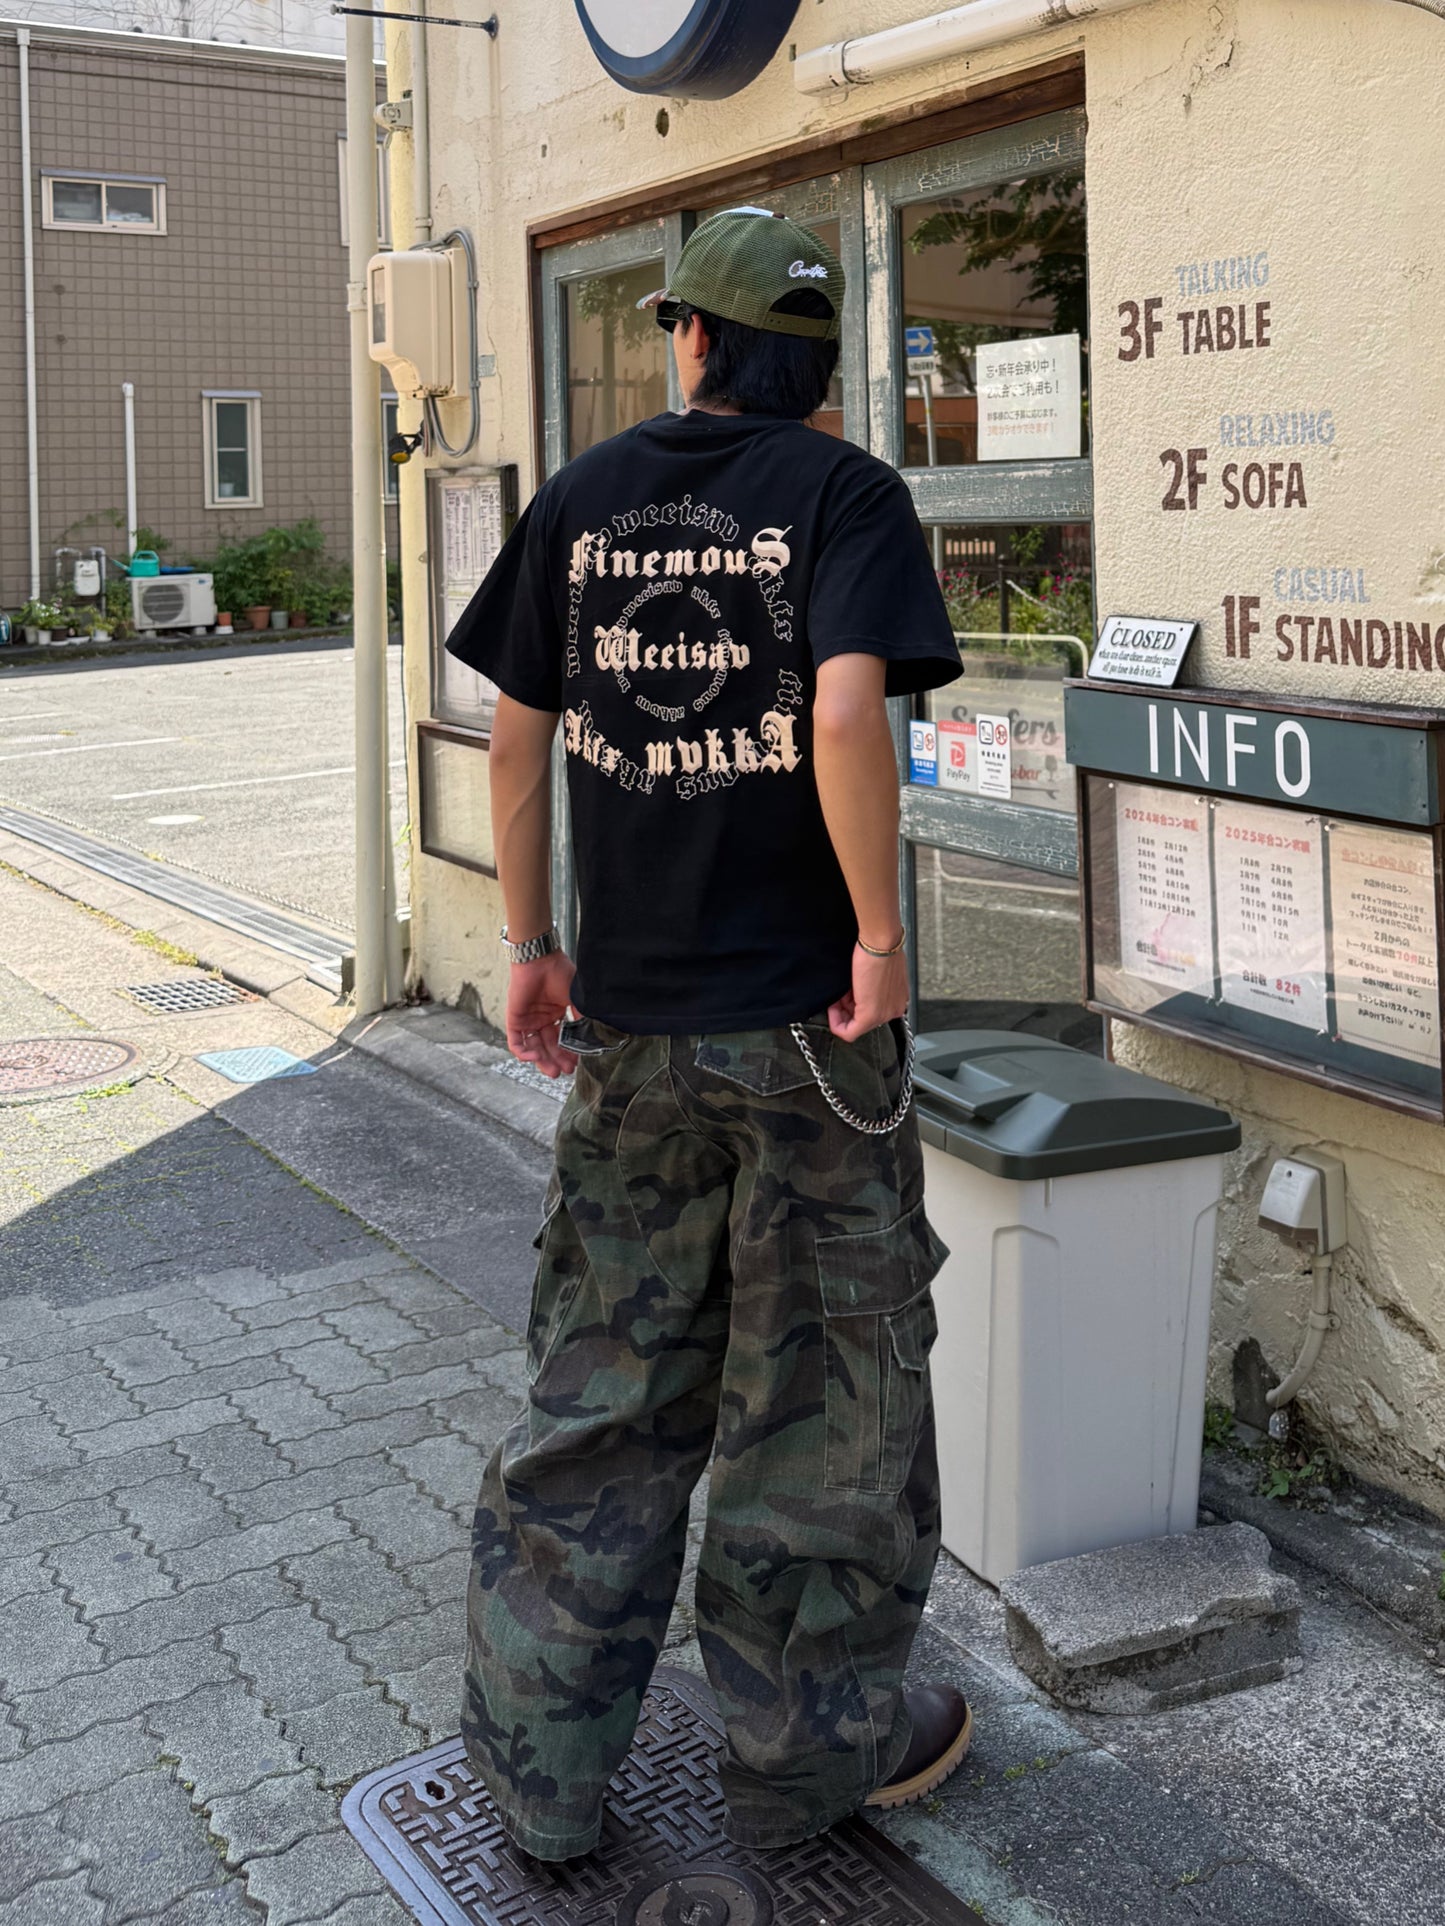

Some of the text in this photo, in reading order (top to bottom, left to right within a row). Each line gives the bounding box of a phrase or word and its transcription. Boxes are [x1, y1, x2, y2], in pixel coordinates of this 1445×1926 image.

[1176, 251, 1269, 297] TALKING
[1117, 297, 1271, 362] 3F TABLE
[1219, 410, 1335, 448] RELAXING
[1159, 448, 1308, 510] 2F SOFA
[1273, 567, 1370, 604] CASUAL
[1110, 627, 1177, 650] CLOSED
[1221, 595, 1260, 660] 1F
[1149, 704, 1311, 798] INFO
[947, 767, 970, 783] PayPay
[1275, 978, 1301, 997] 82件
